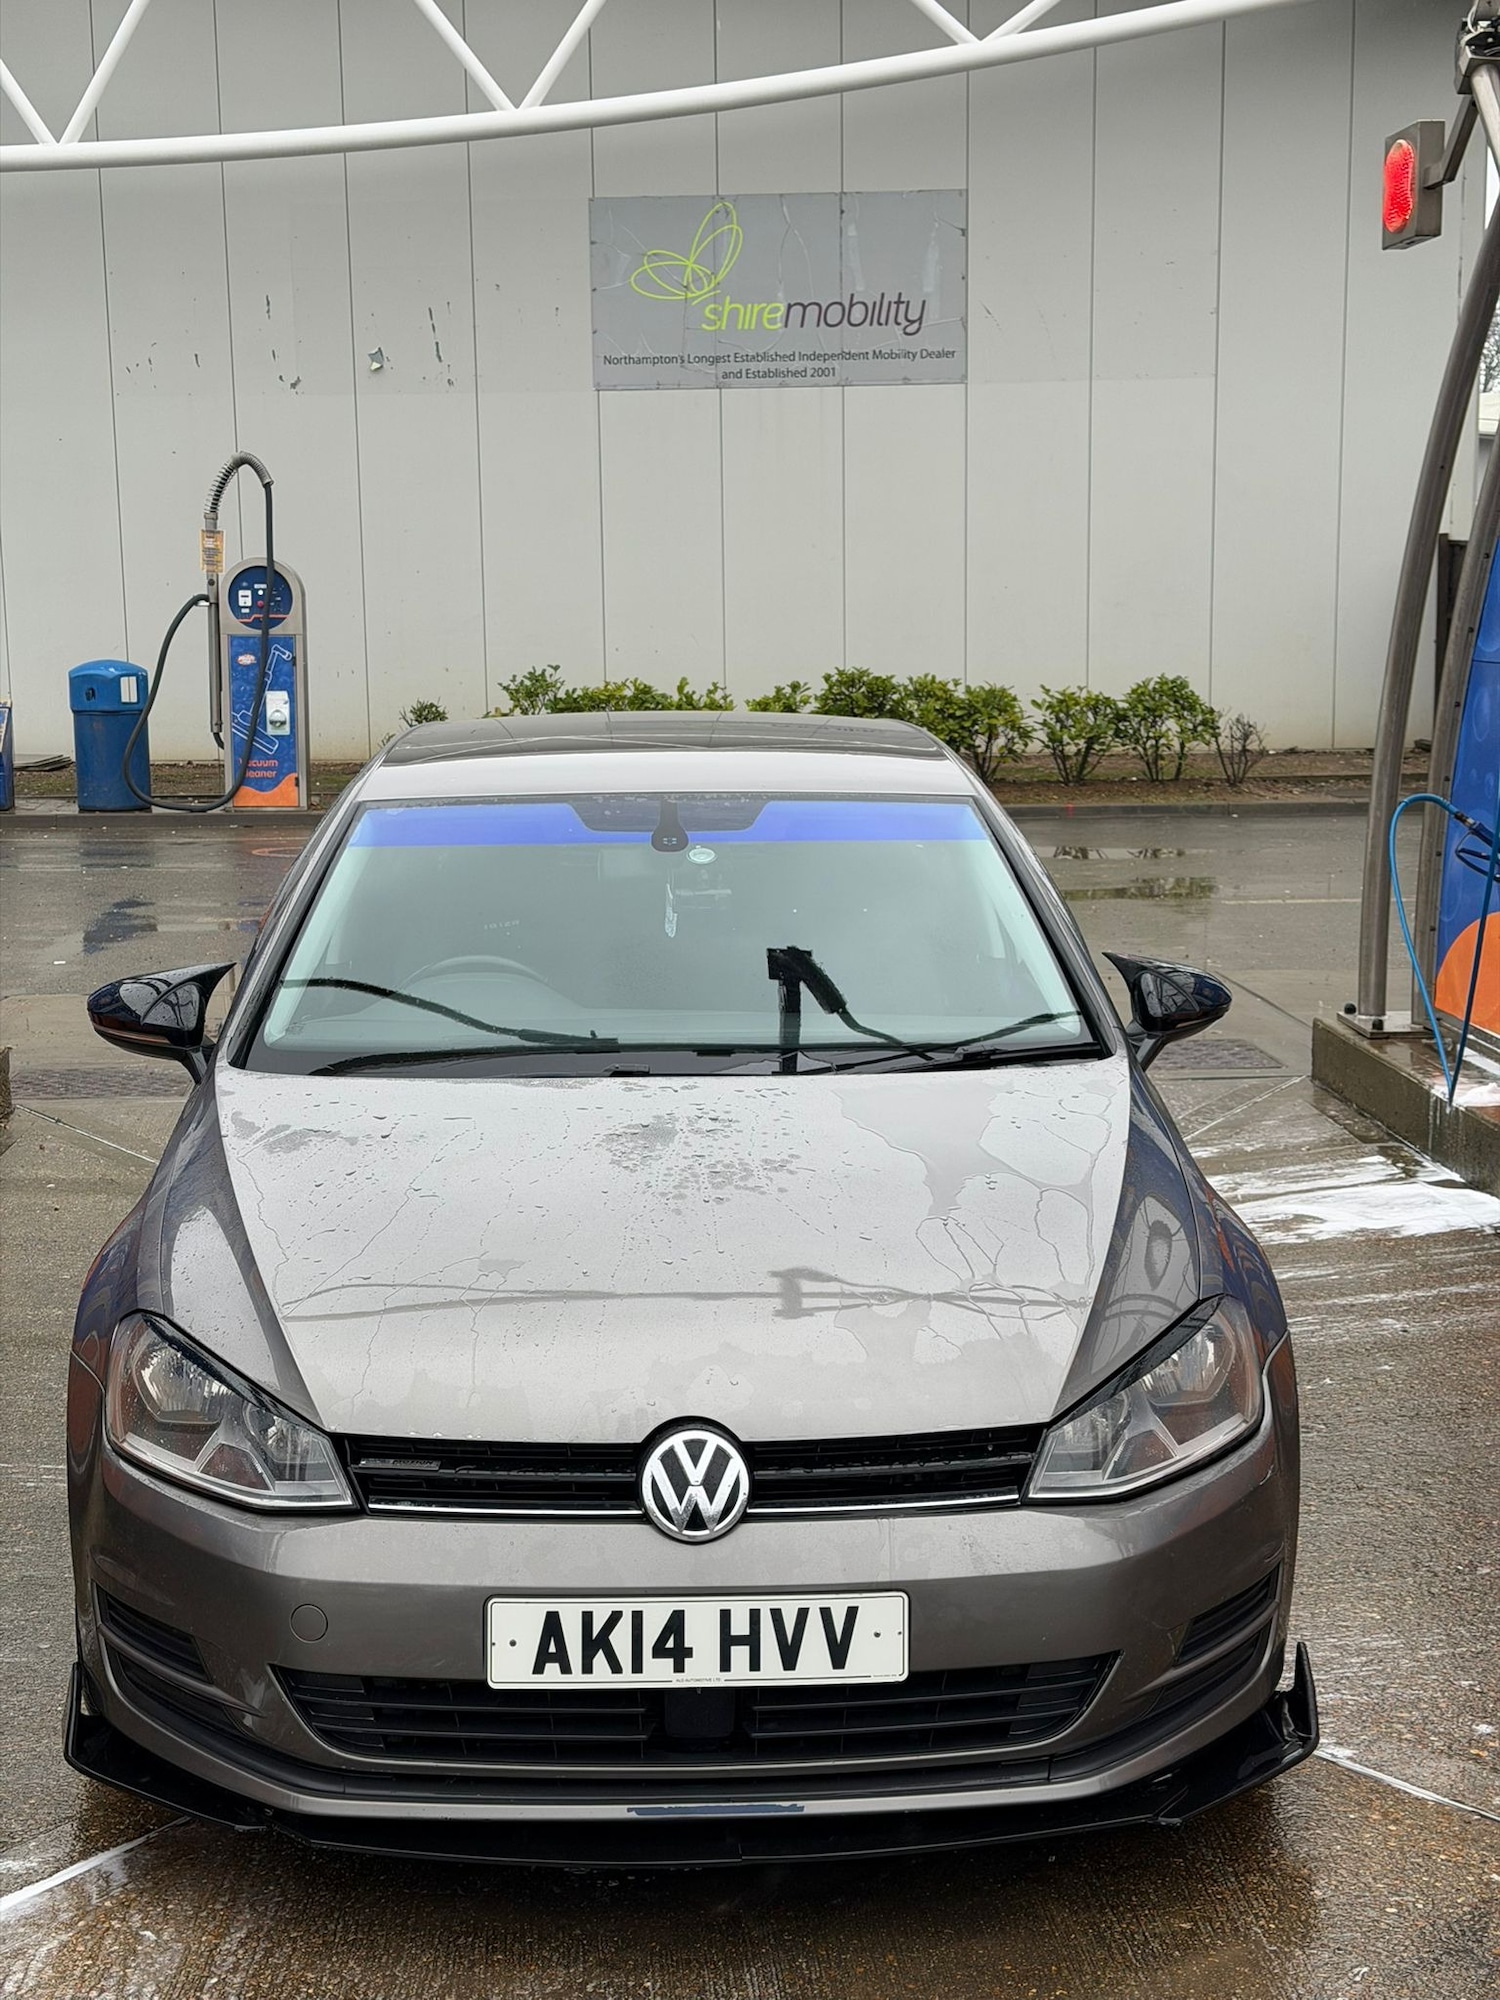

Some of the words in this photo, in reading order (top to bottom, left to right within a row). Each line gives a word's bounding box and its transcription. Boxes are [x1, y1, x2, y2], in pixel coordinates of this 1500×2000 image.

[701, 292, 926, 336] shiremobility
[603, 354, 685, 366] Northampton's
[687, 352, 731, 367] Longest
[734, 350, 796, 363] Established
[799, 349, 869, 363] Independent
[872, 348, 918, 361] Mobility
[920, 347, 956, 359] Dealer
[721, 368, 743, 379] and
[746, 366, 807, 379] Established
[810, 366, 836, 378] 2001
[245, 769, 277, 778] leaner
[719, 1606, 859, 1672] HVV
